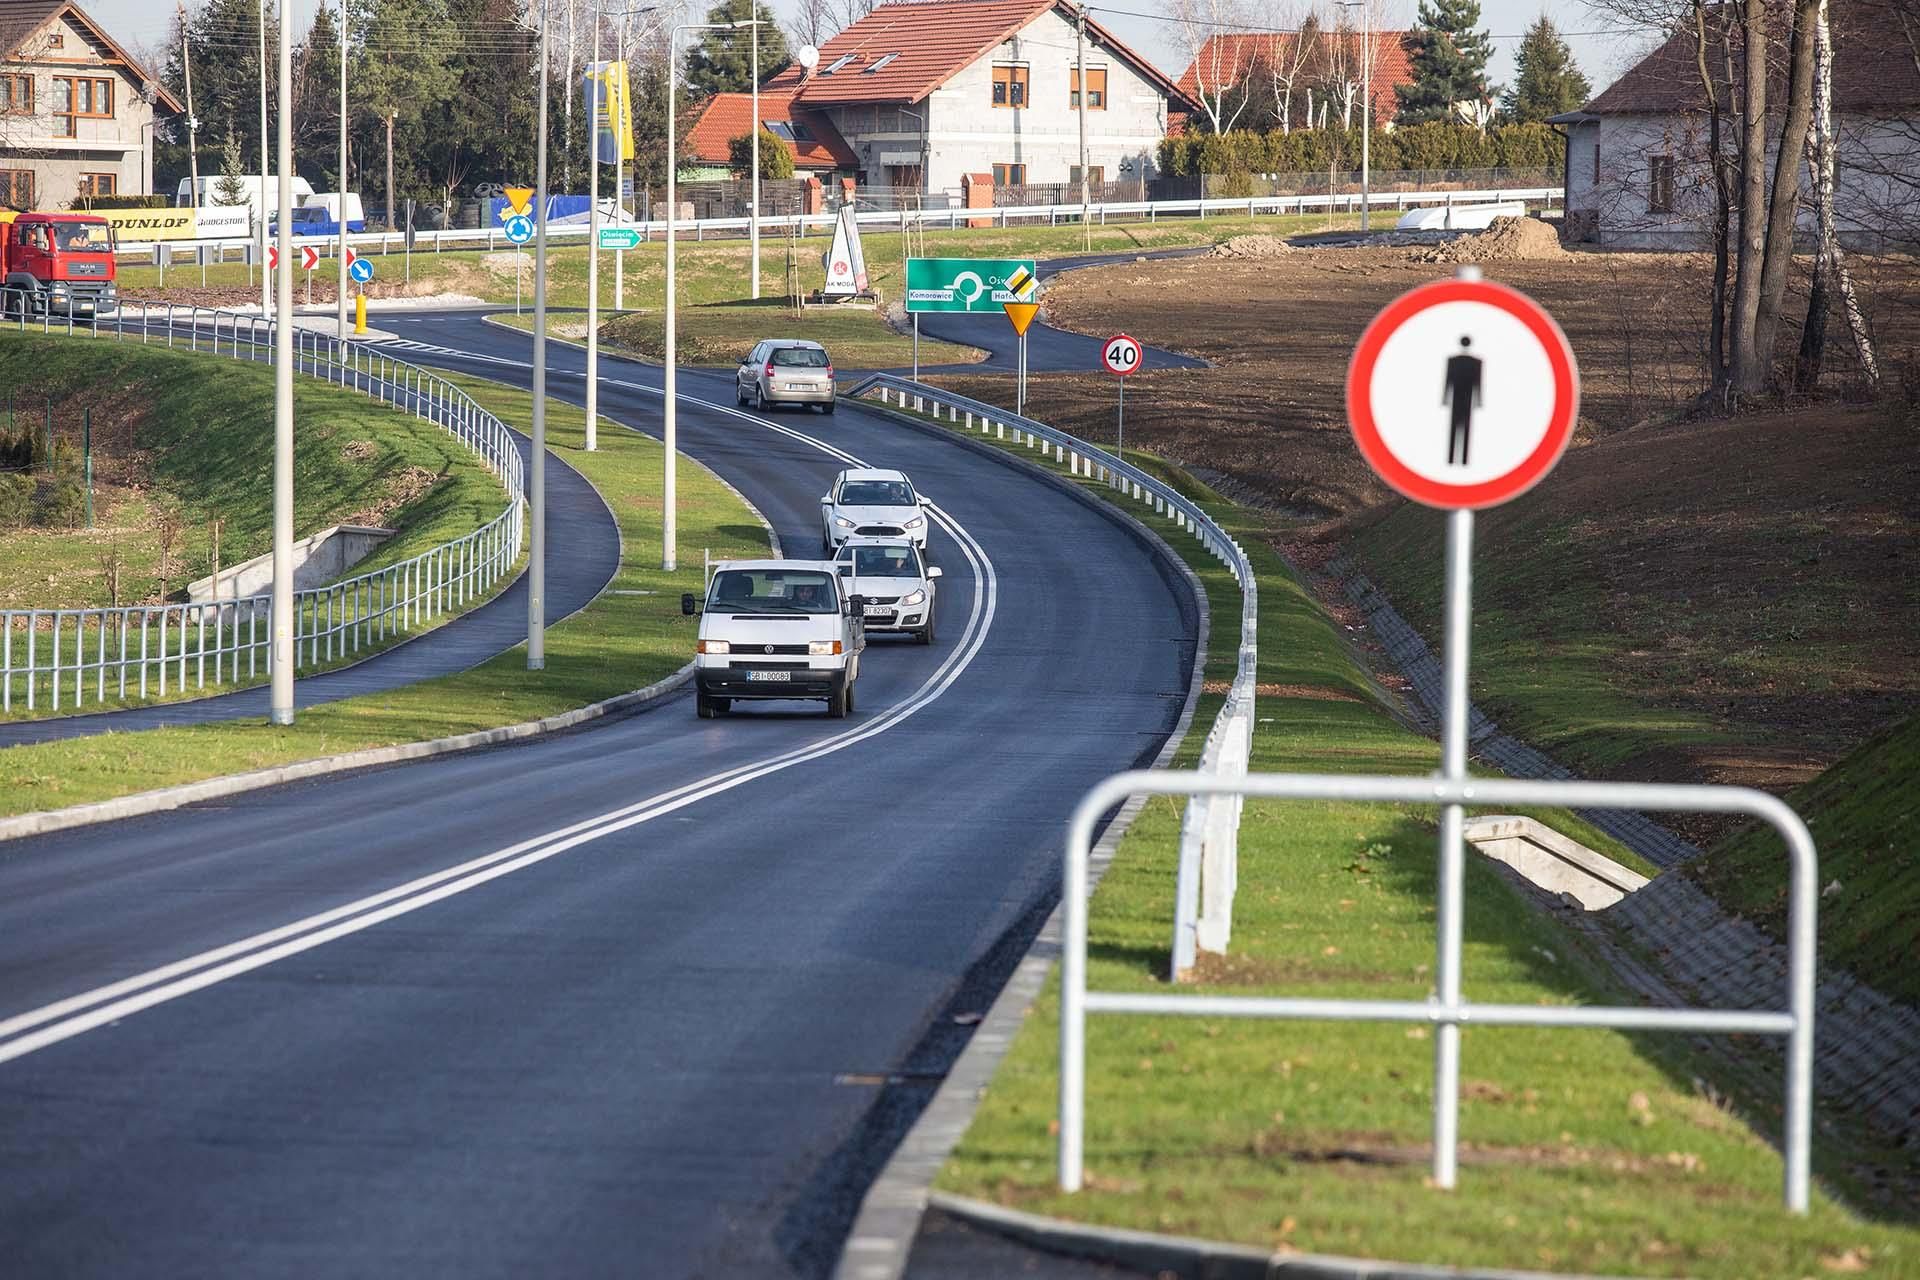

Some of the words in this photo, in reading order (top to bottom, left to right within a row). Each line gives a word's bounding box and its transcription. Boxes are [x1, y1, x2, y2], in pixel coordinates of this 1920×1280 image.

[110, 218, 189, 229] DUNLOP
[909, 290, 953, 300] Komorowice
[1108, 345, 1136, 365] 40
[751, 671, 764, 680] SBI
